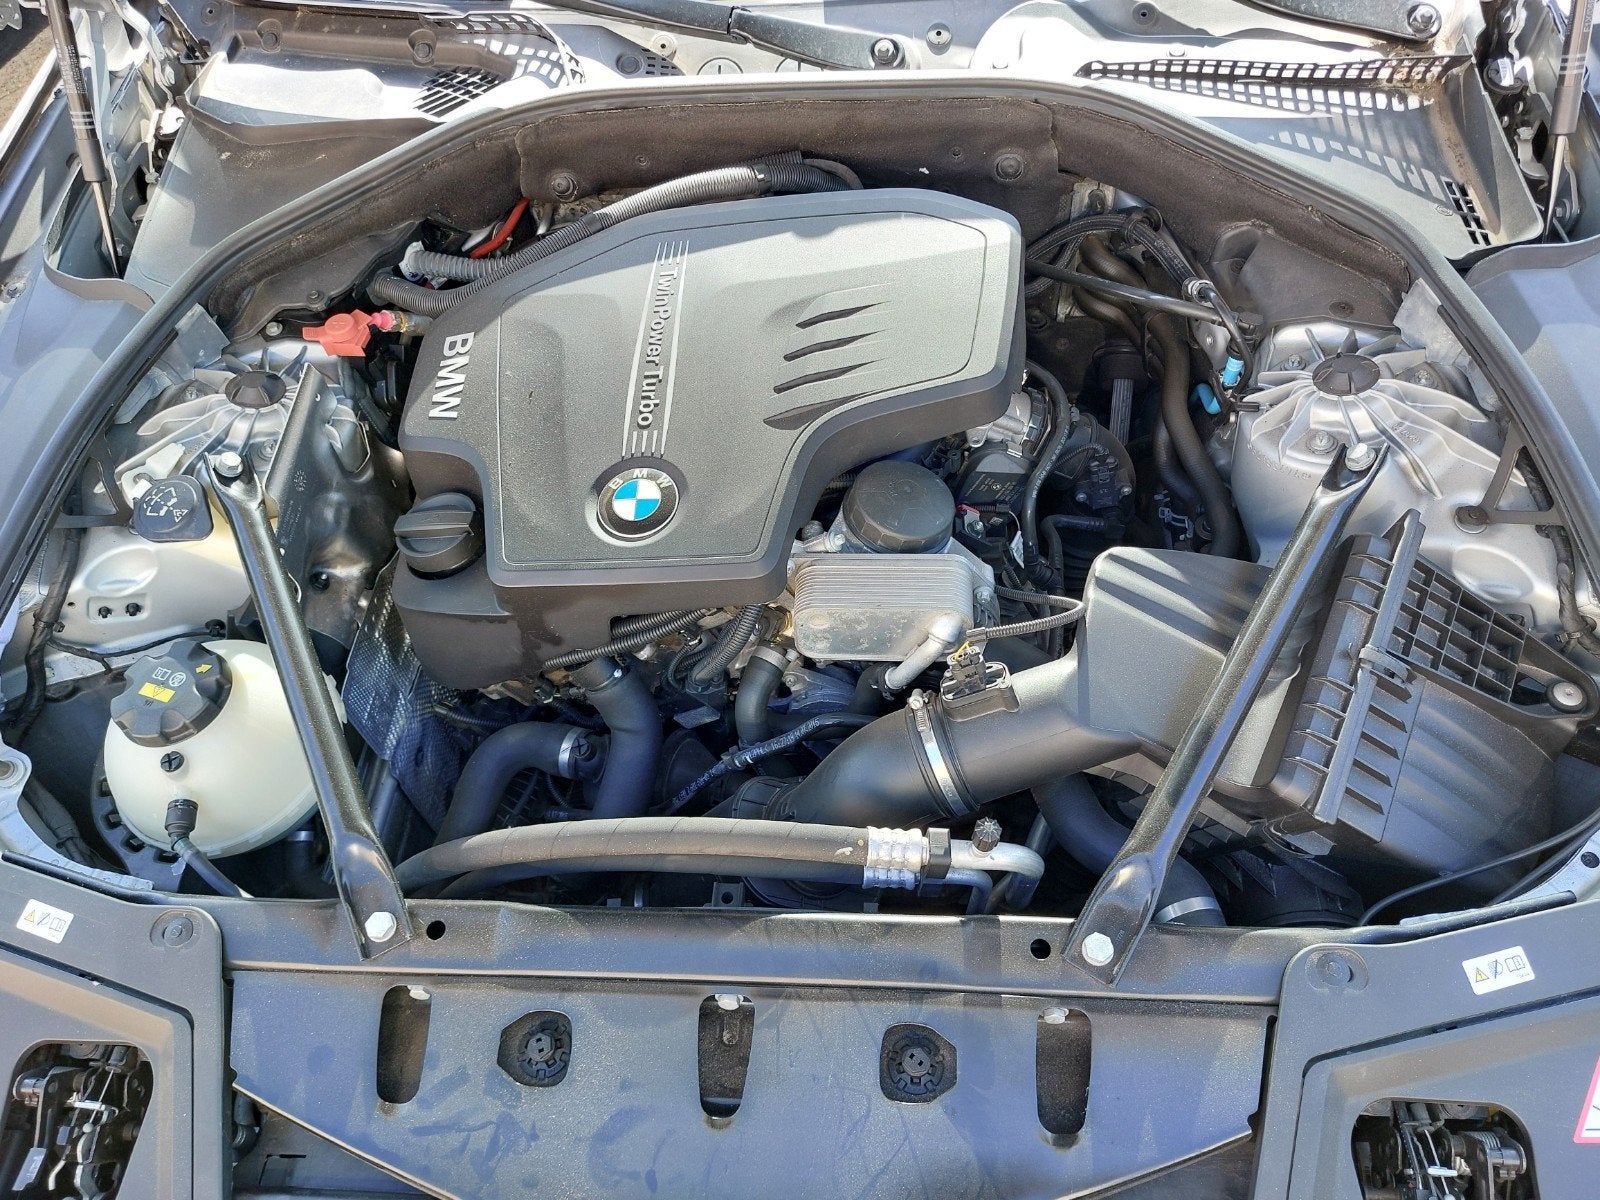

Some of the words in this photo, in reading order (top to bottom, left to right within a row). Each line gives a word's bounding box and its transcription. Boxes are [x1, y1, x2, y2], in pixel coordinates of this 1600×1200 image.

[646, 267, 678, 366] TwinPower
[429, 332, 475, 420] BMW
[637, 366, 664, 429] Turbo
[608, 468, 673, 490] BMW
